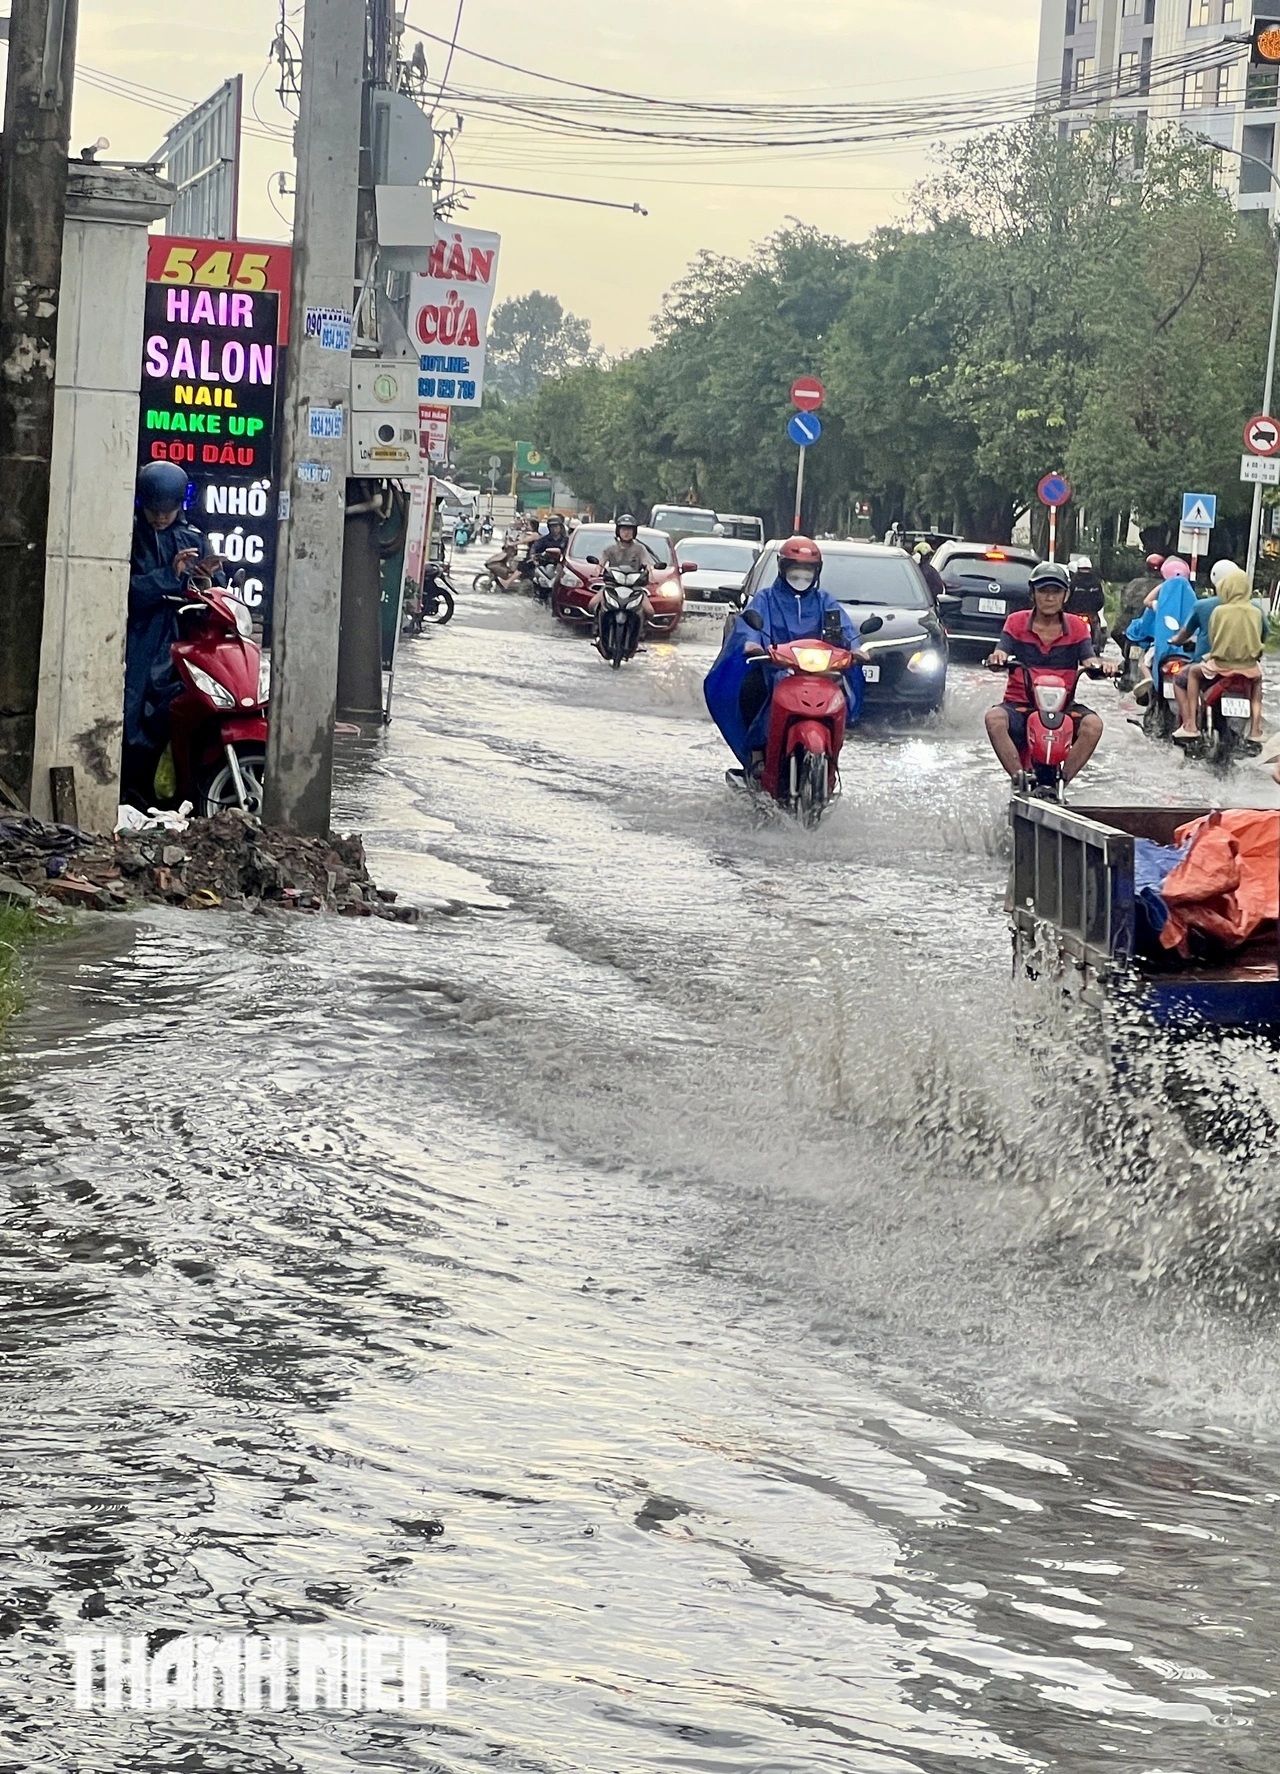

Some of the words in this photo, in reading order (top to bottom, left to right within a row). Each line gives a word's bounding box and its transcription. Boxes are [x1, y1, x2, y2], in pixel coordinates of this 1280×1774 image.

[160, 247, 271, 291] 545
[167, 288, 254, 328] HAIR
[416, 290, 480, 347] CỬA
[145, 335, 273, 385] SALON
[420, 355, 469, 374] HOTLINE:
[174, 384, 238, 408] NAIL
[146, 410, 221, 434] MAKE
[228, 416, 264, 437] UP
[151, 439, 194, 464] GỘI
[202, 439, 254, 466] ĐẦU
[205, 479, 271, 516] NHỔ
[207, 526, 264, 563] TÓC
